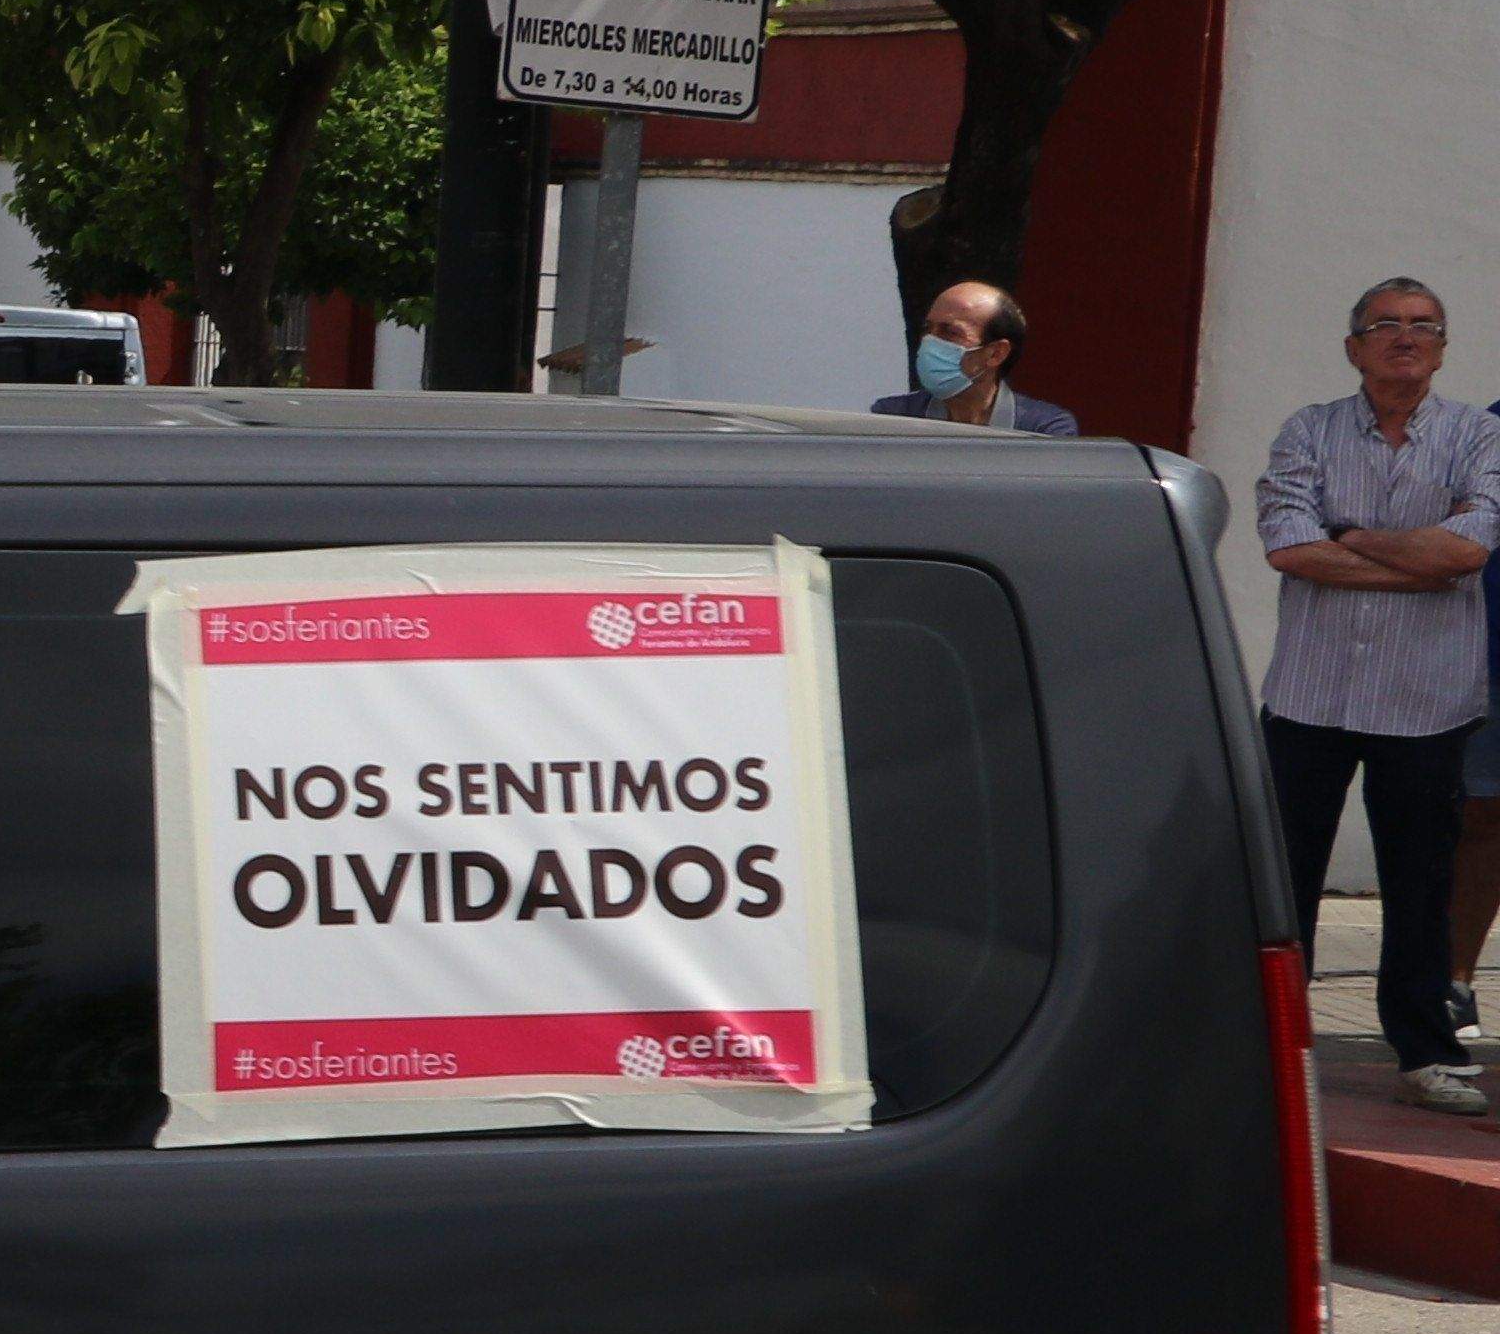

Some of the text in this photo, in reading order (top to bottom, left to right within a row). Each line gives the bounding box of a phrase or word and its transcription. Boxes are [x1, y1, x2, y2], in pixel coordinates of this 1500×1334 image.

[515, 17, 755, 64] MIERCOLES MERCADILLO
[520, 67, 547, 87] De
[553, 70, 596, 94] 7,30
[602, 79, 615, 94] a
[683, 82, 742, 106] Horas
[207, 606, 431, 643] #sosferiantes
[634, 593, 745, 624] cefan
[235, 756, 771, 821] NOS SENTIMOS
[233, 843, 784, 929] OLVIDADOS
[665, 1026, 776, 1059] cefan
[233, 1044, 458, 1080] #sosferiantes
